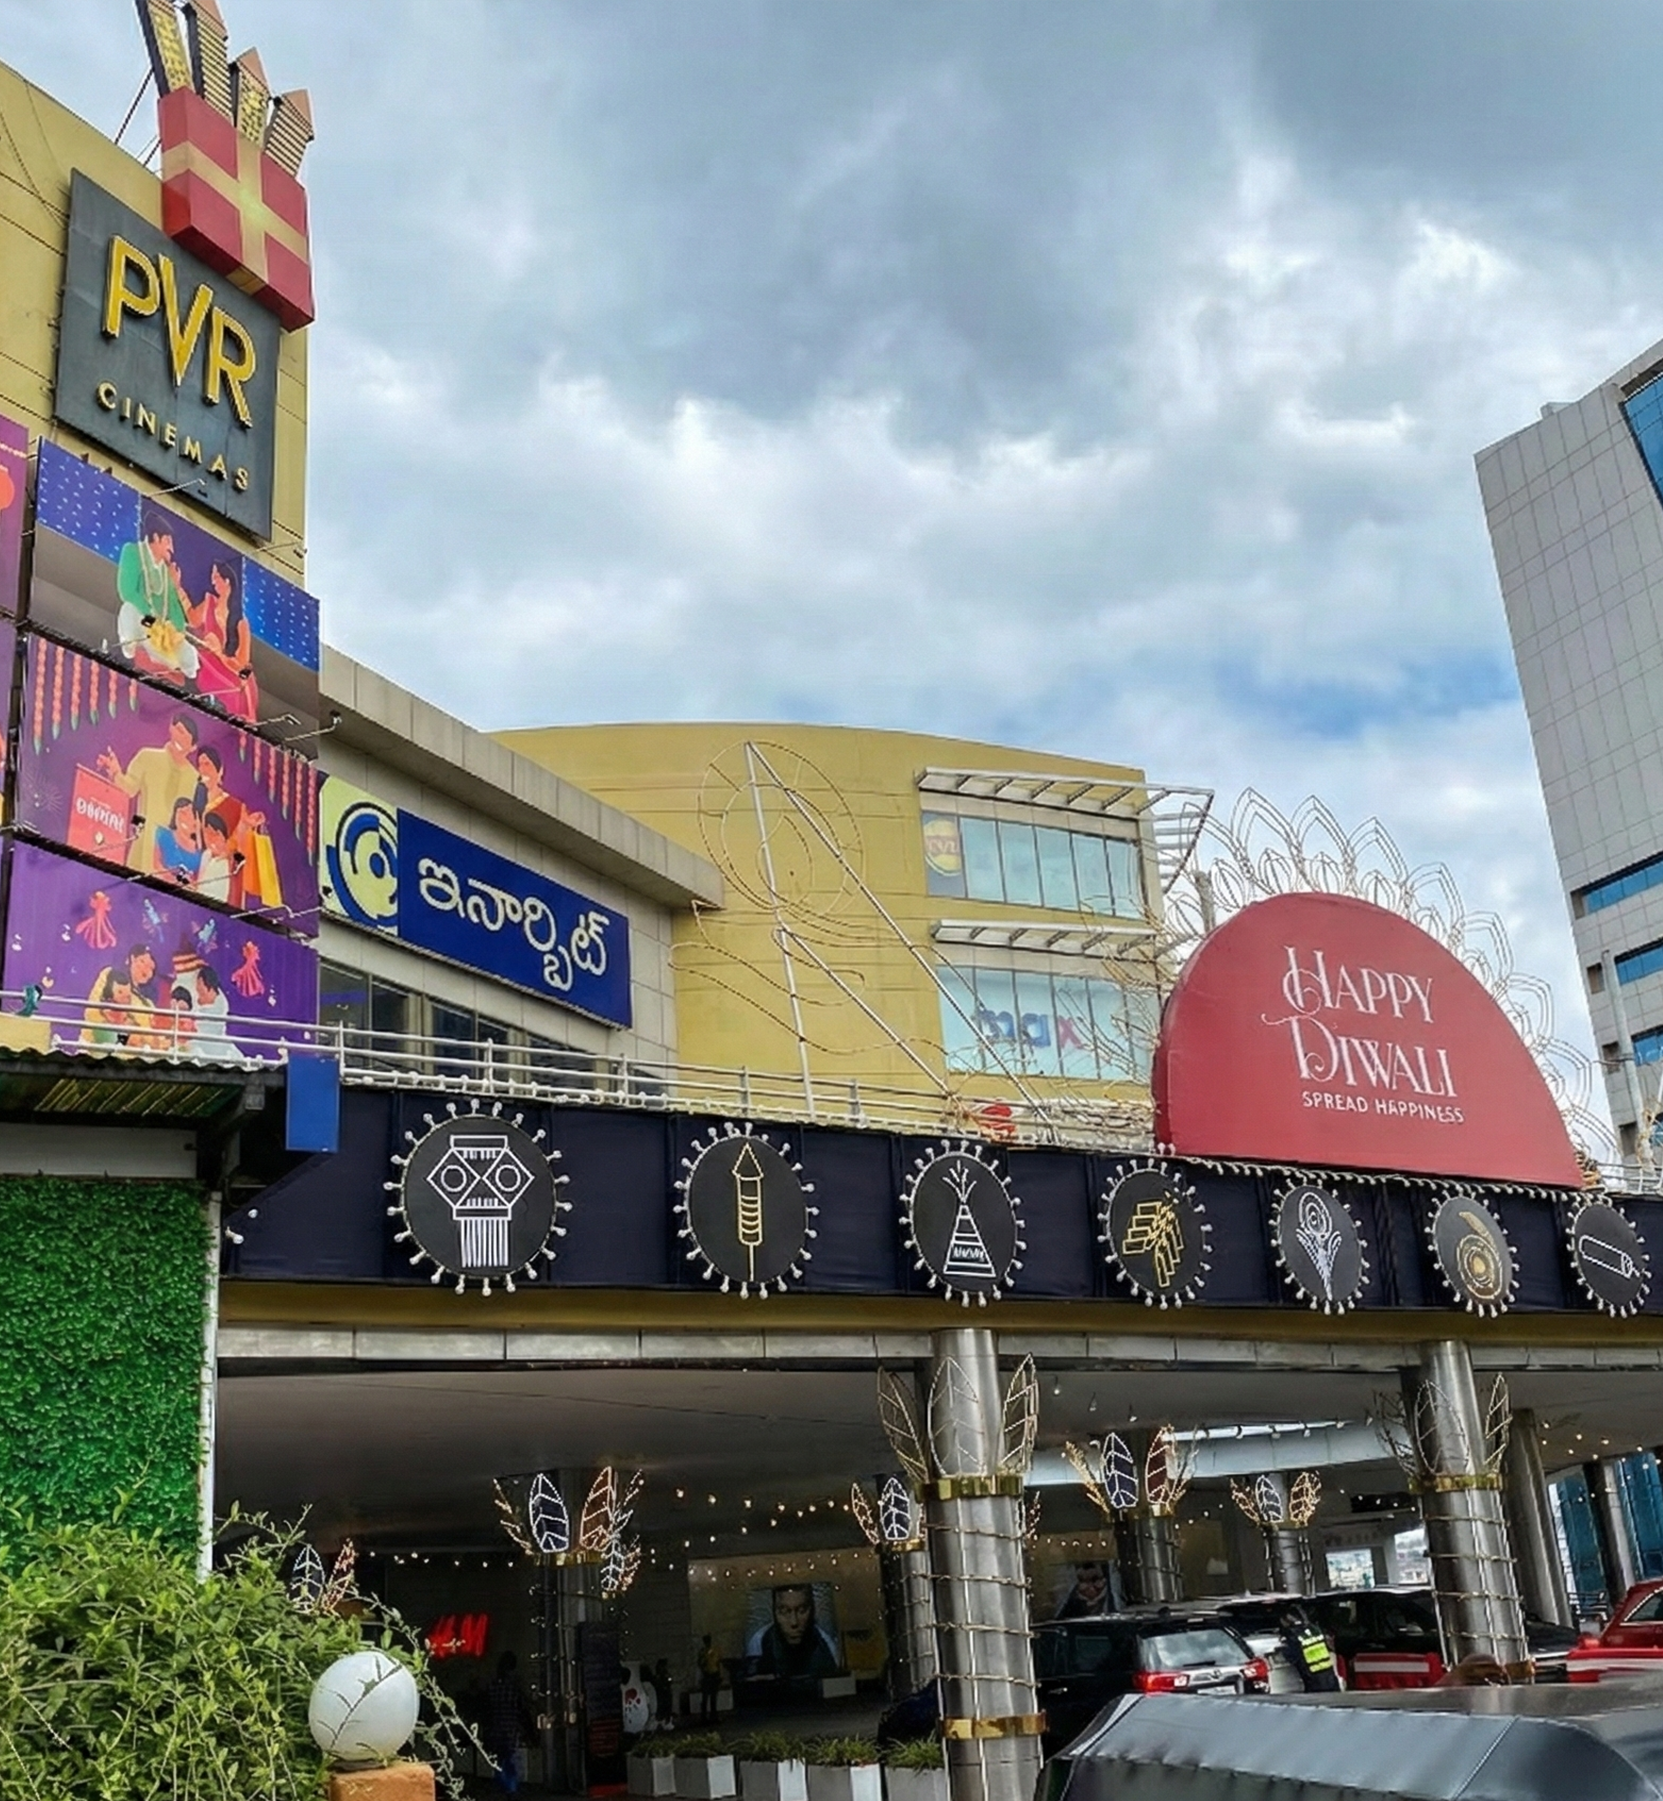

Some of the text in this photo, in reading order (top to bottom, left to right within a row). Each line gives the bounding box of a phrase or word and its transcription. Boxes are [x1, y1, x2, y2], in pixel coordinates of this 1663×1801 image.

[102, 234, 257, 428] PVR
[96, 381, 249, 492] CINEMAS
[1281, 945, 1433, 1023] HAPPY
[976, 1009, 1083, 1048] max
[1261, 1012, 1458, 1098] DIWALI
[1302, 1090, 1464, 1124] SPREAD HAPPINESS
